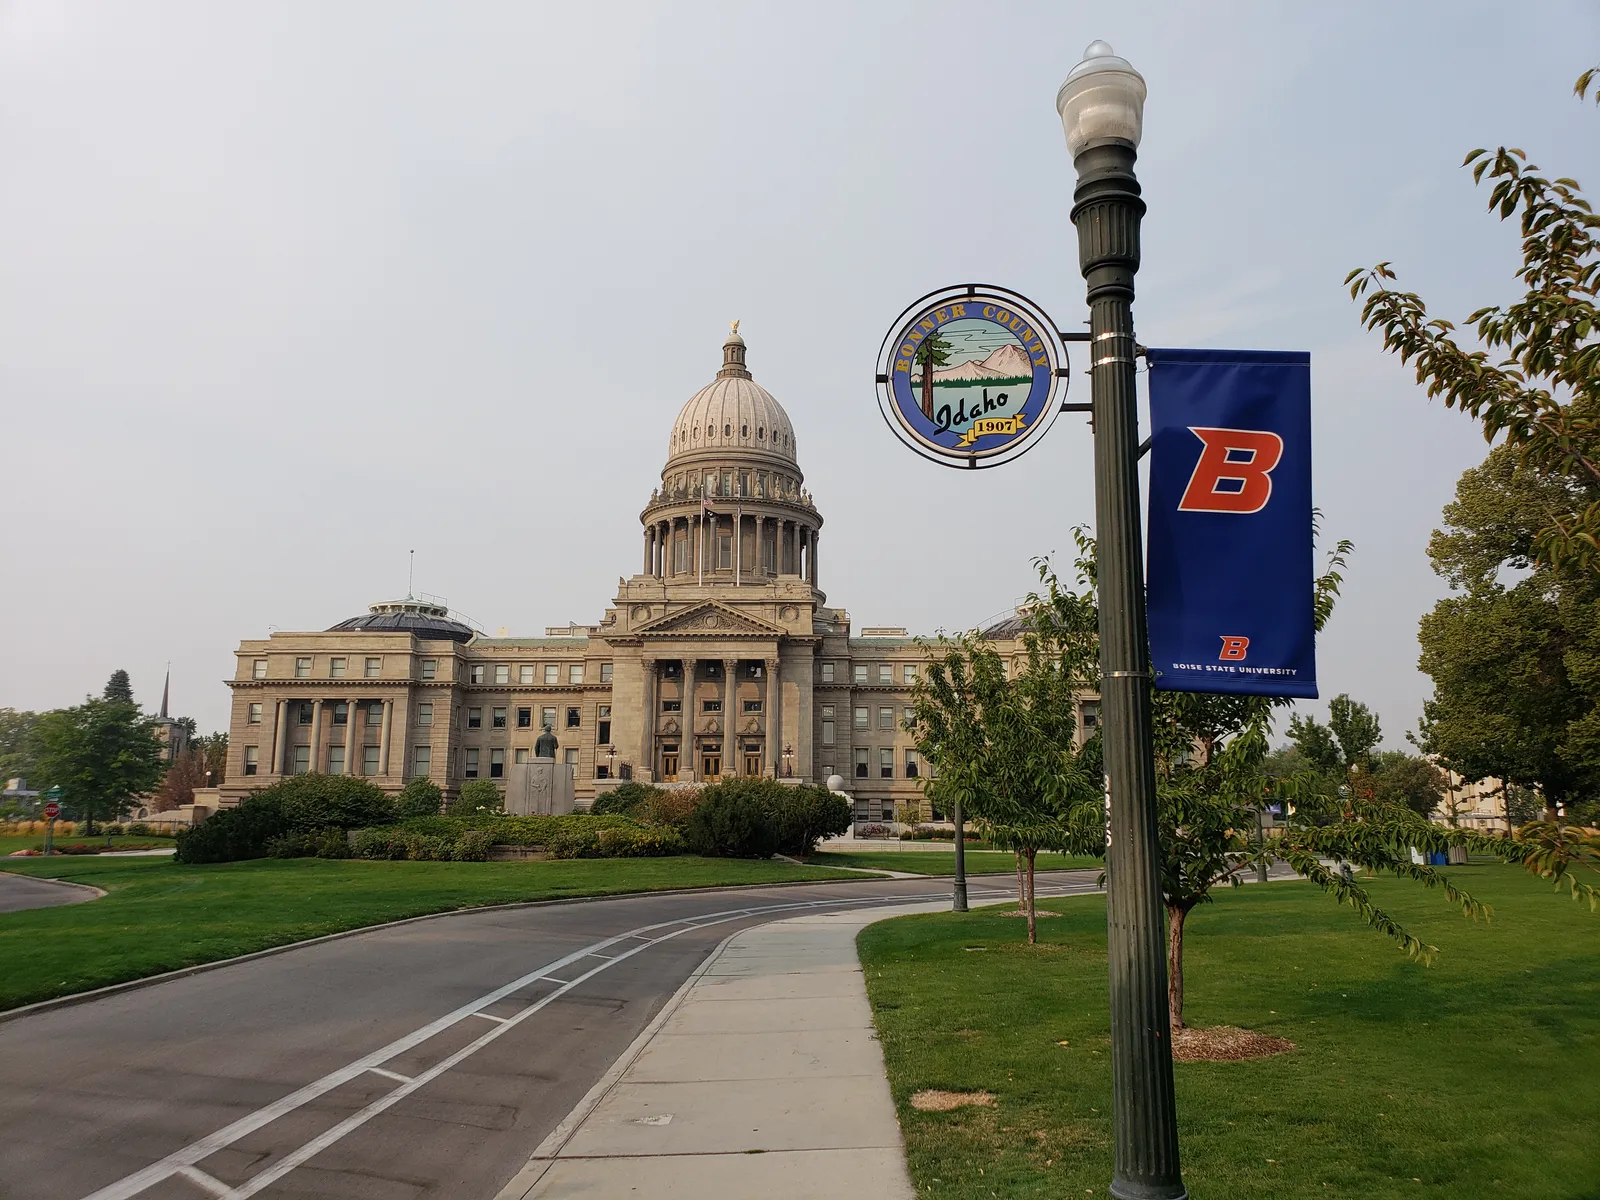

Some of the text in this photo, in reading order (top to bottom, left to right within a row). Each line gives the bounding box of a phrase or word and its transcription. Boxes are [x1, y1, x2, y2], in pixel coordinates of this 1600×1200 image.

[896, 303, 1049, 373] BONNER COUNTY
[933, 388, 1009, 436] Idaho
[977, 420, 1014, 433] 1907
[1177, 426, 1284, 514] B
[1218, 635, 1250, 661] B
[1172, 663, 1297, 676] BOISE STATE UNIVERSITY
